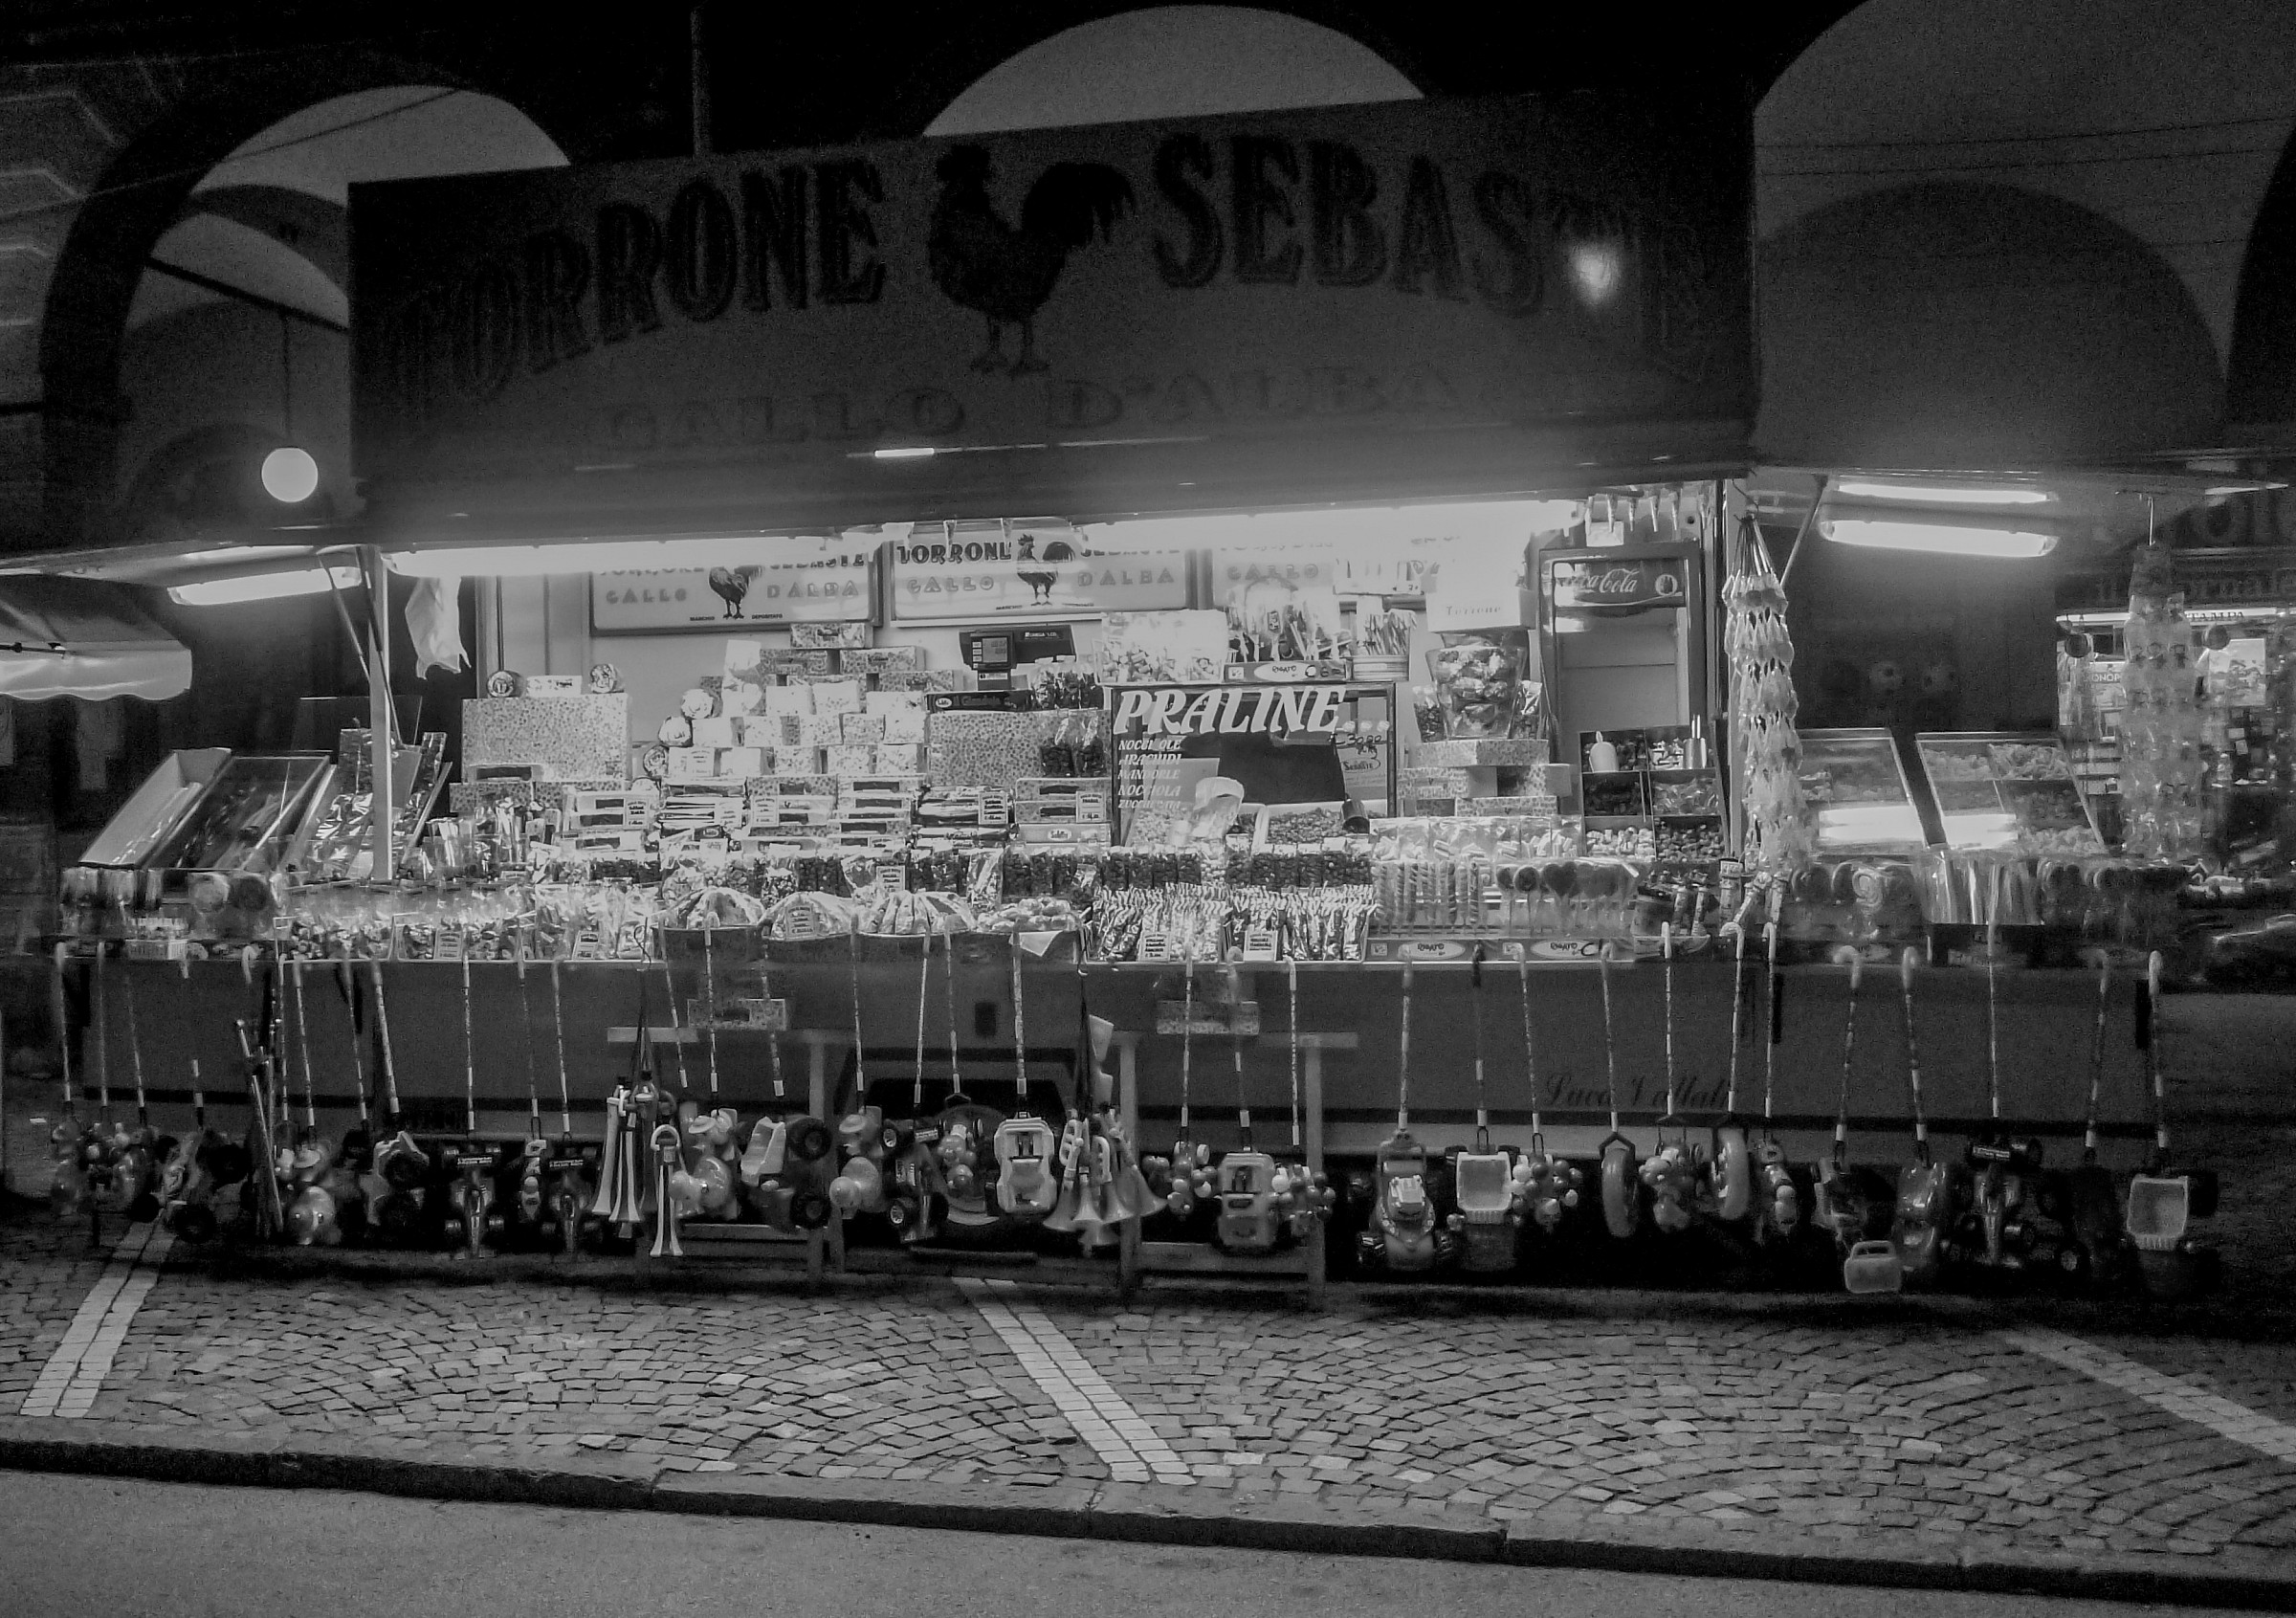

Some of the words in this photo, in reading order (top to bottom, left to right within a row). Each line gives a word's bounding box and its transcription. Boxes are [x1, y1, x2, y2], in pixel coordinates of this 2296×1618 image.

[1225, 563, 1319, 581] GALLO
[605, 587, 688, 605] GALLO
[766, 579, 860, 600] D'ALBA
[906, 575, 995, 594] GALLO
[1114, 684, 1347, 735] PRALINE
[1117, 784, 1182, 796] NOCIOLA
